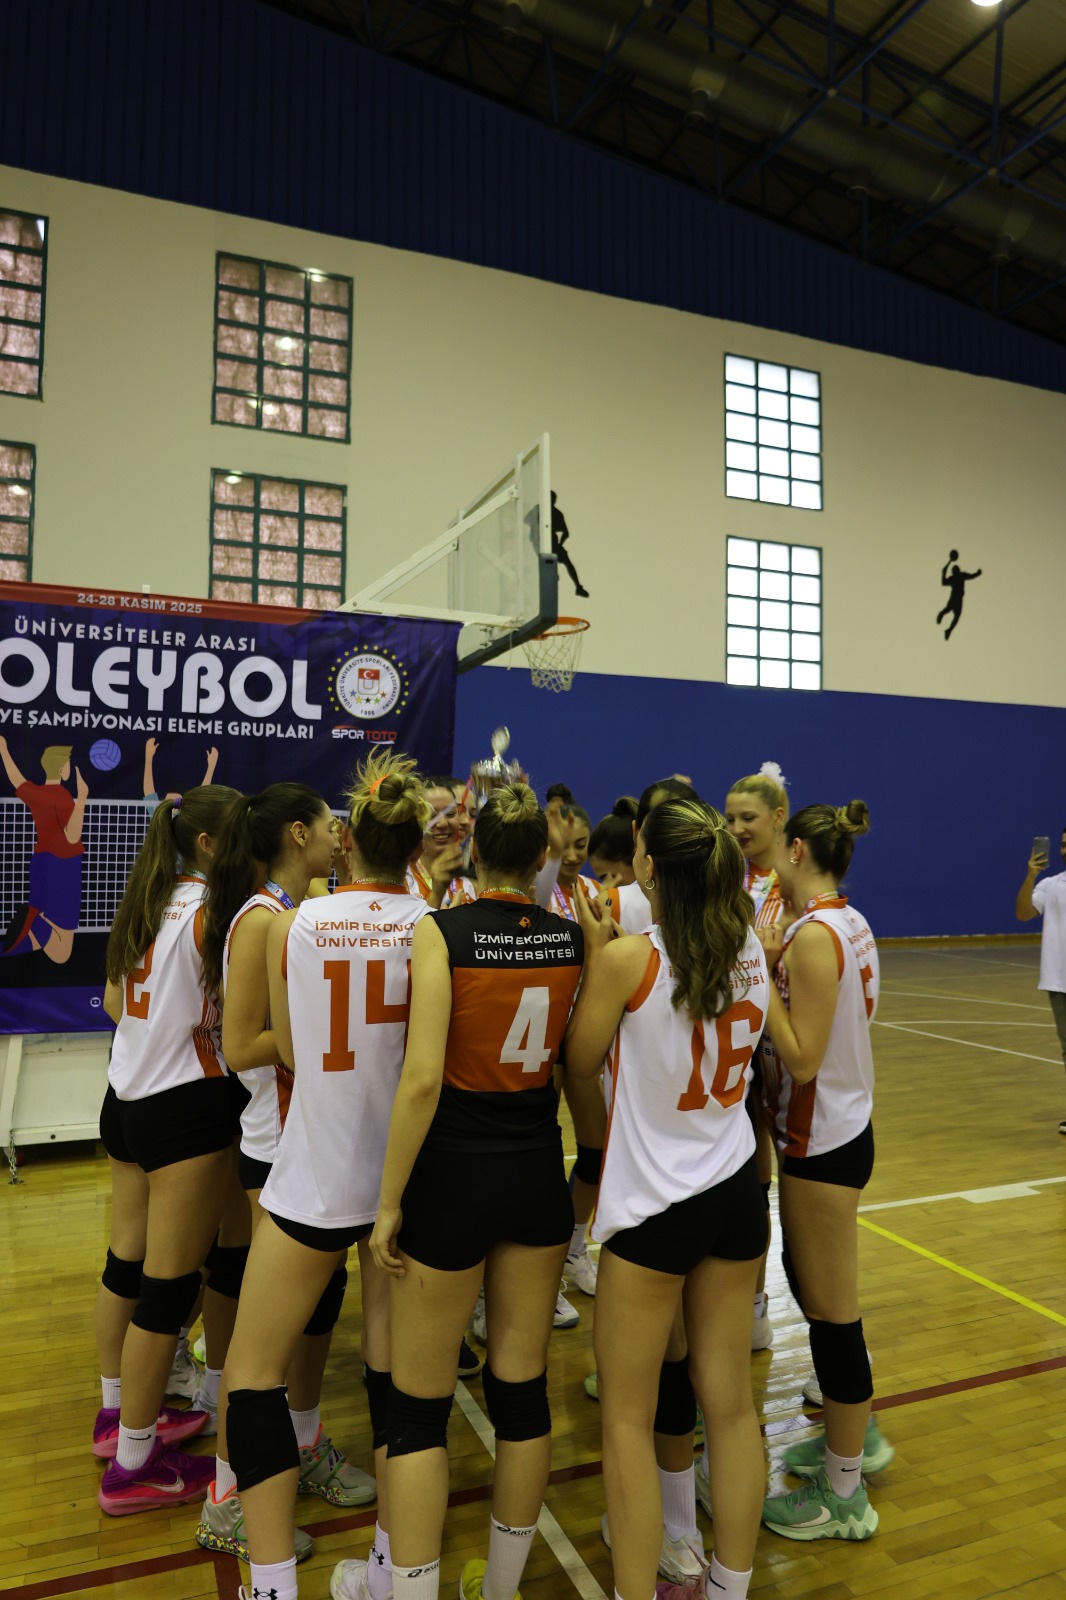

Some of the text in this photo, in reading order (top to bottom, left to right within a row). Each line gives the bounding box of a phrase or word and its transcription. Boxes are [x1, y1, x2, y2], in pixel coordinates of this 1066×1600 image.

[77, 592, 203, 614] 24-28 KASIM 2025
[14, 615, 256, 652] ÜNİVERSİTELER ARASI
[27, 709, 163, 733] ŞAMPİYONASI
[168, 717, 223, 735] ELEME
[227, 721, 314, 739] GRUPLARI
[315, 919, 360, 932] İZMİR
[473, 930, 572, 946] İZMİR EKONOMİ
[316, 935, 412, 948] ÜNİVERSİTE
[474, 945, 575, 961] ÜNİVERSİTESİ
[322, 958, 413, 1073] 14
[499, 986, 552, 1073] 4
[676, 999, 764, 1112] 16
